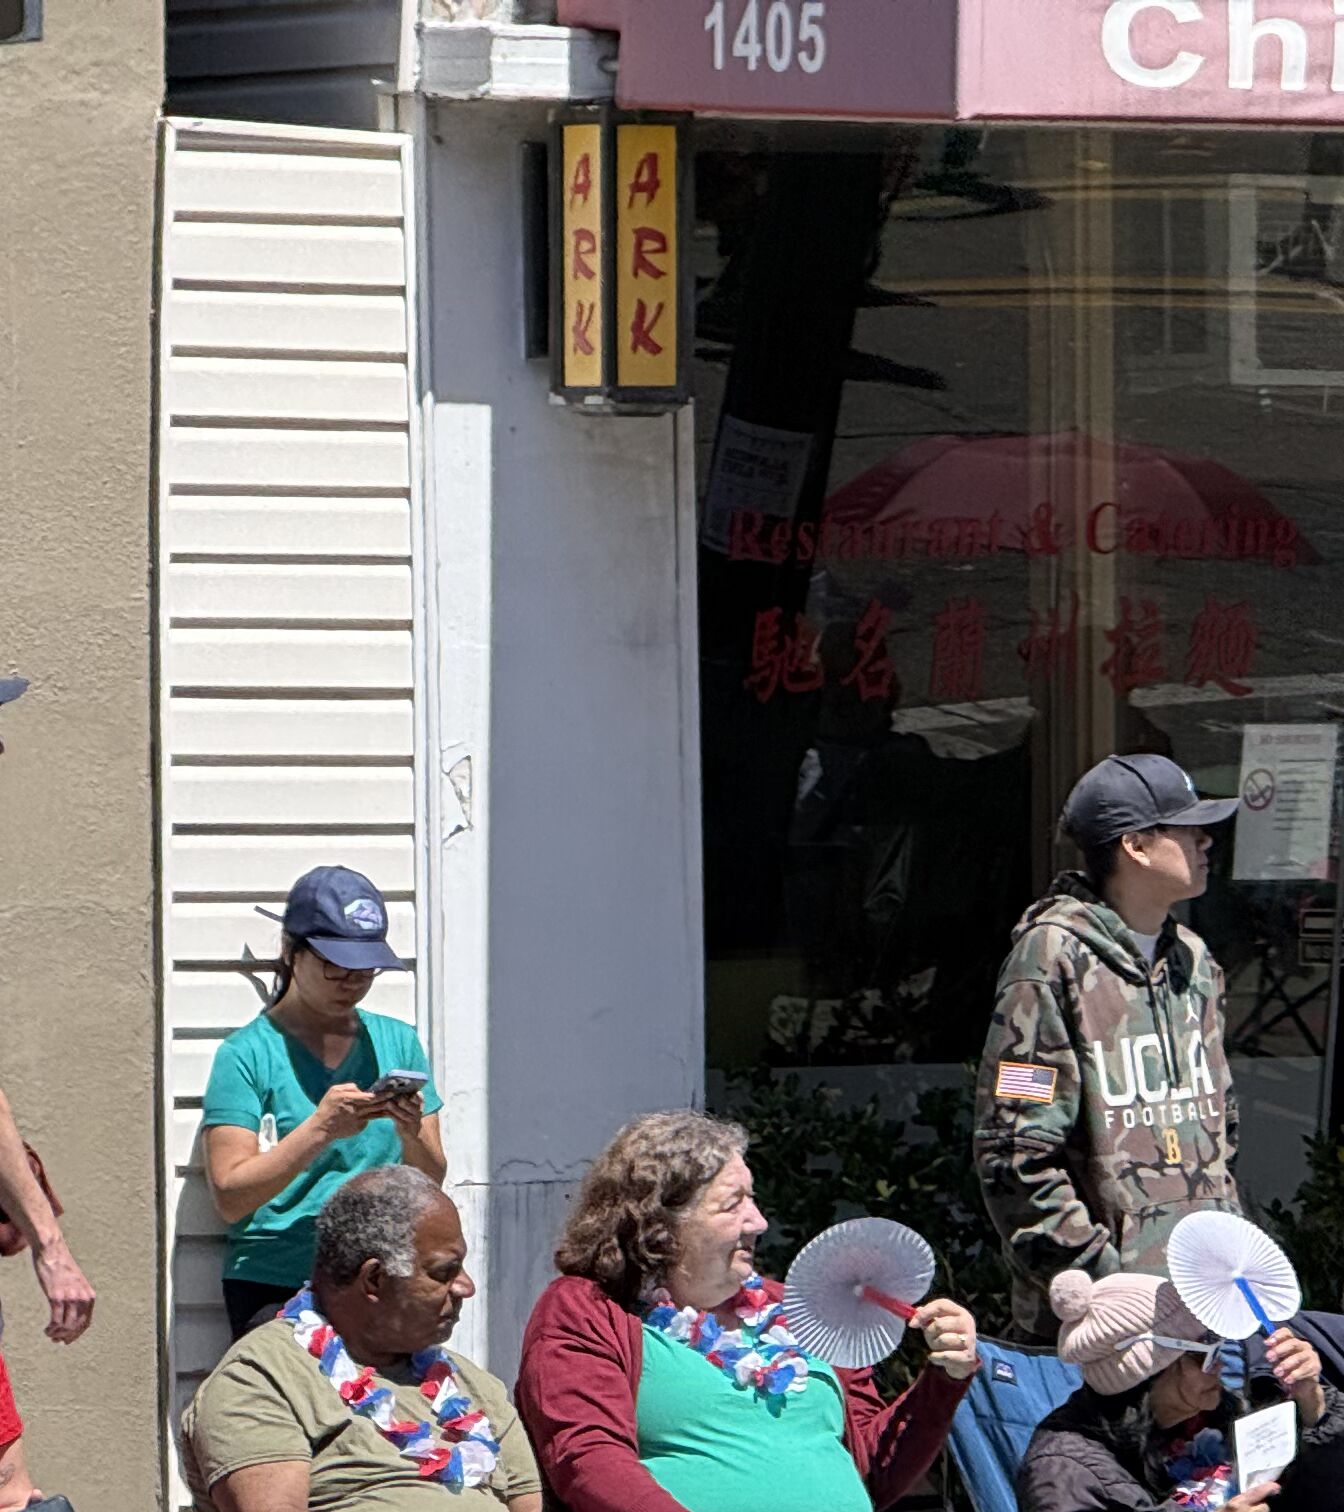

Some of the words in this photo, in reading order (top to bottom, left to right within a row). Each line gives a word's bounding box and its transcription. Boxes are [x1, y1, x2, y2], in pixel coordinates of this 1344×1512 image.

[704, 0, 828, 74] 1405
[569, 152, 598, 358] ARK
[627, 151, 668, 357] ARK
[726, 508, 1008, 562] Restaurant
[1023, 501, 1063, 556] &
[1087, 500, 1299, 568] Catering
[1093, 1029, 1217, 1107] UCLA
[1104, 1098, 1221, 1129] FOOTBALL
